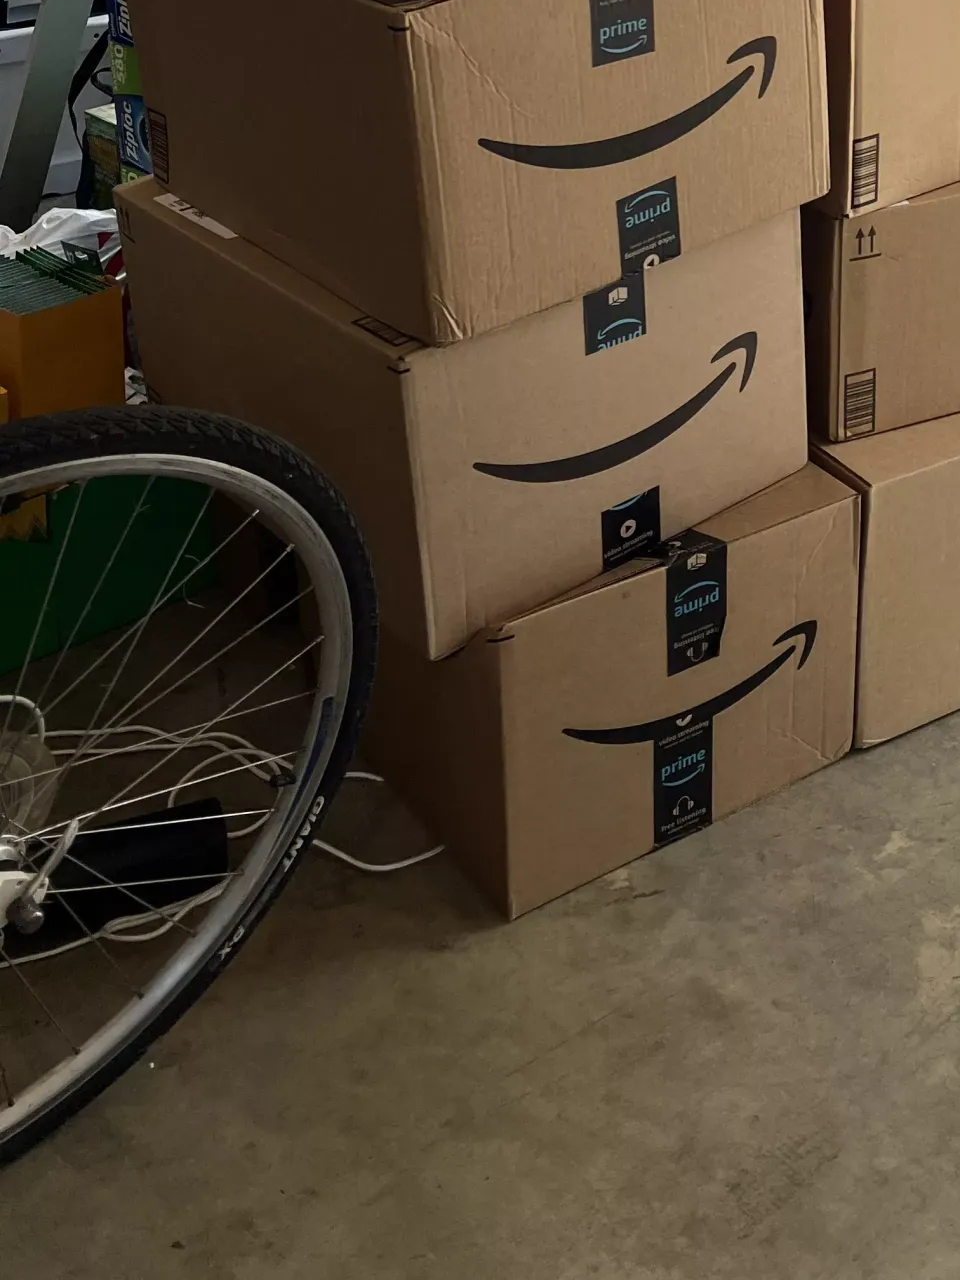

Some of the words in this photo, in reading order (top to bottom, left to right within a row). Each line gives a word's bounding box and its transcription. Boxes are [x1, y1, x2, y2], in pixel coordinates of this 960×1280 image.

[600, 18, 647, 45] prime
[114, 44, 125, 85] 580
[122, 100, 139, 161] Ziploc
[625, 197, 671, 229] prime
[674, 587, 719, 618] prime
[661, 749, 707, 781] prime
[283, 795, 325, 873] GIANT
